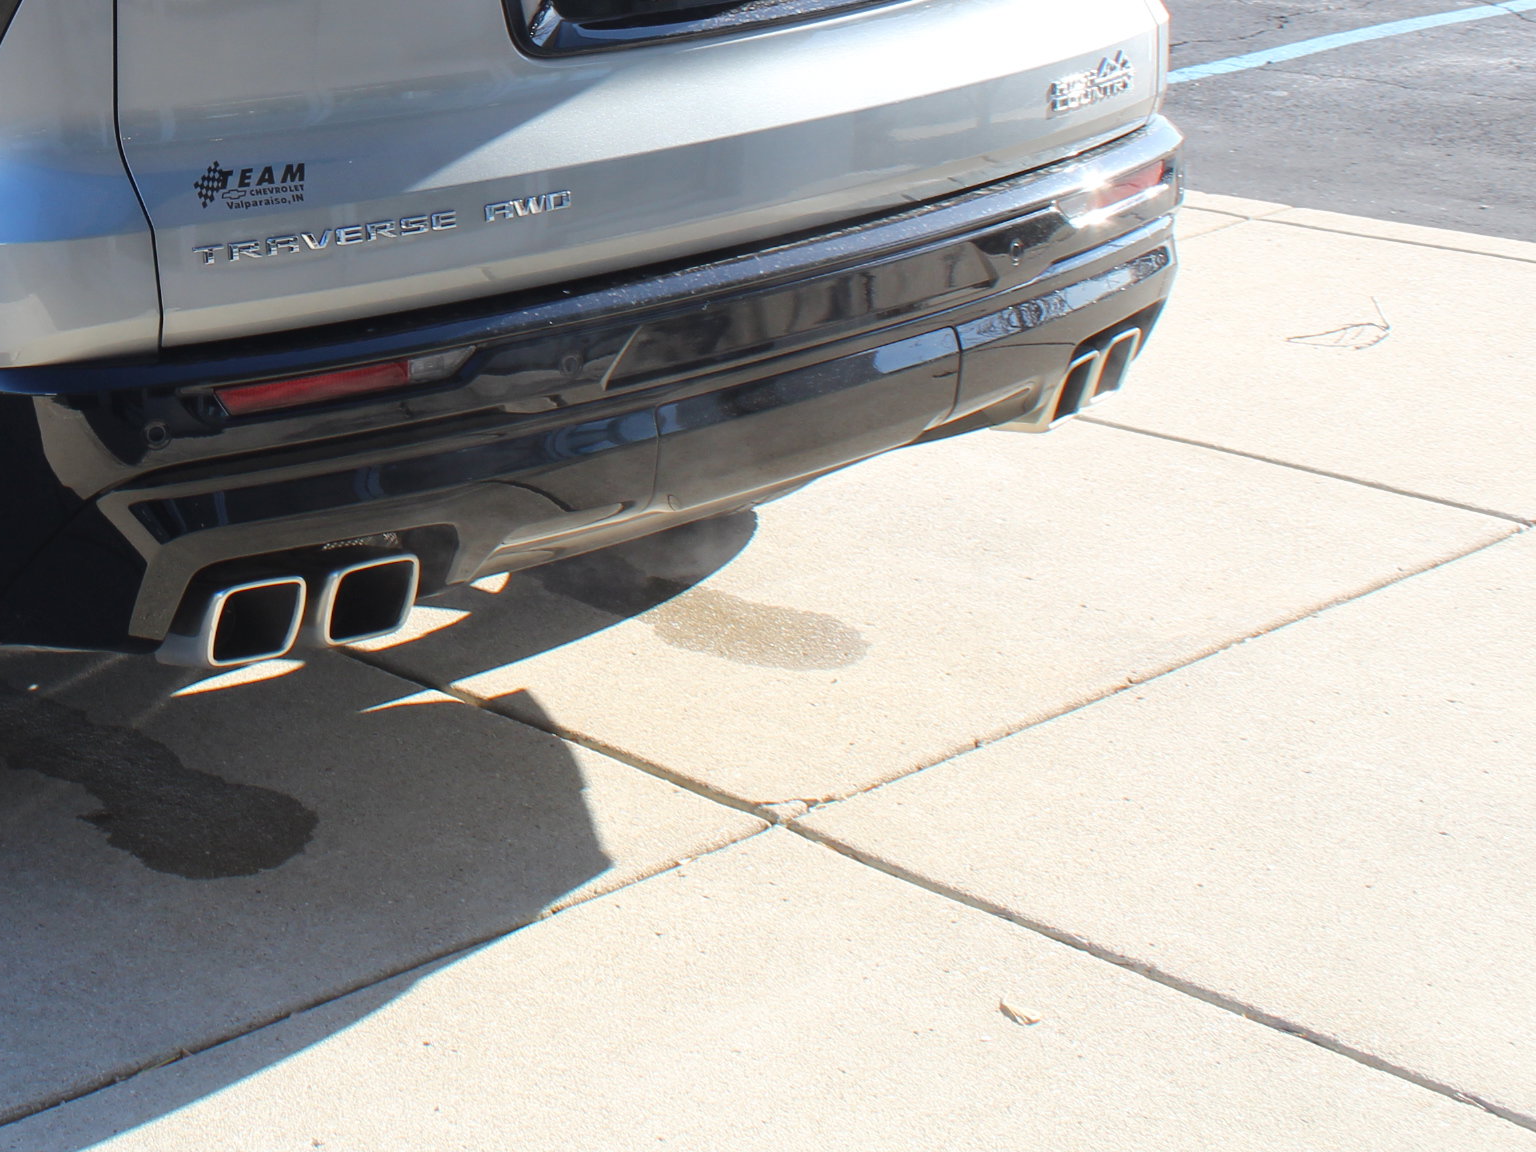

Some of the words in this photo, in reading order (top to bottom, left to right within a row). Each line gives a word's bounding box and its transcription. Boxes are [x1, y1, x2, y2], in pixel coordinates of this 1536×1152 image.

[220, 162, 305, 189] TEAM
[249, 183, 305, 197] CHEVROLET
[192, 209, 458, 266] TRAVERSE
[484, 189, 572, 223] AWD
